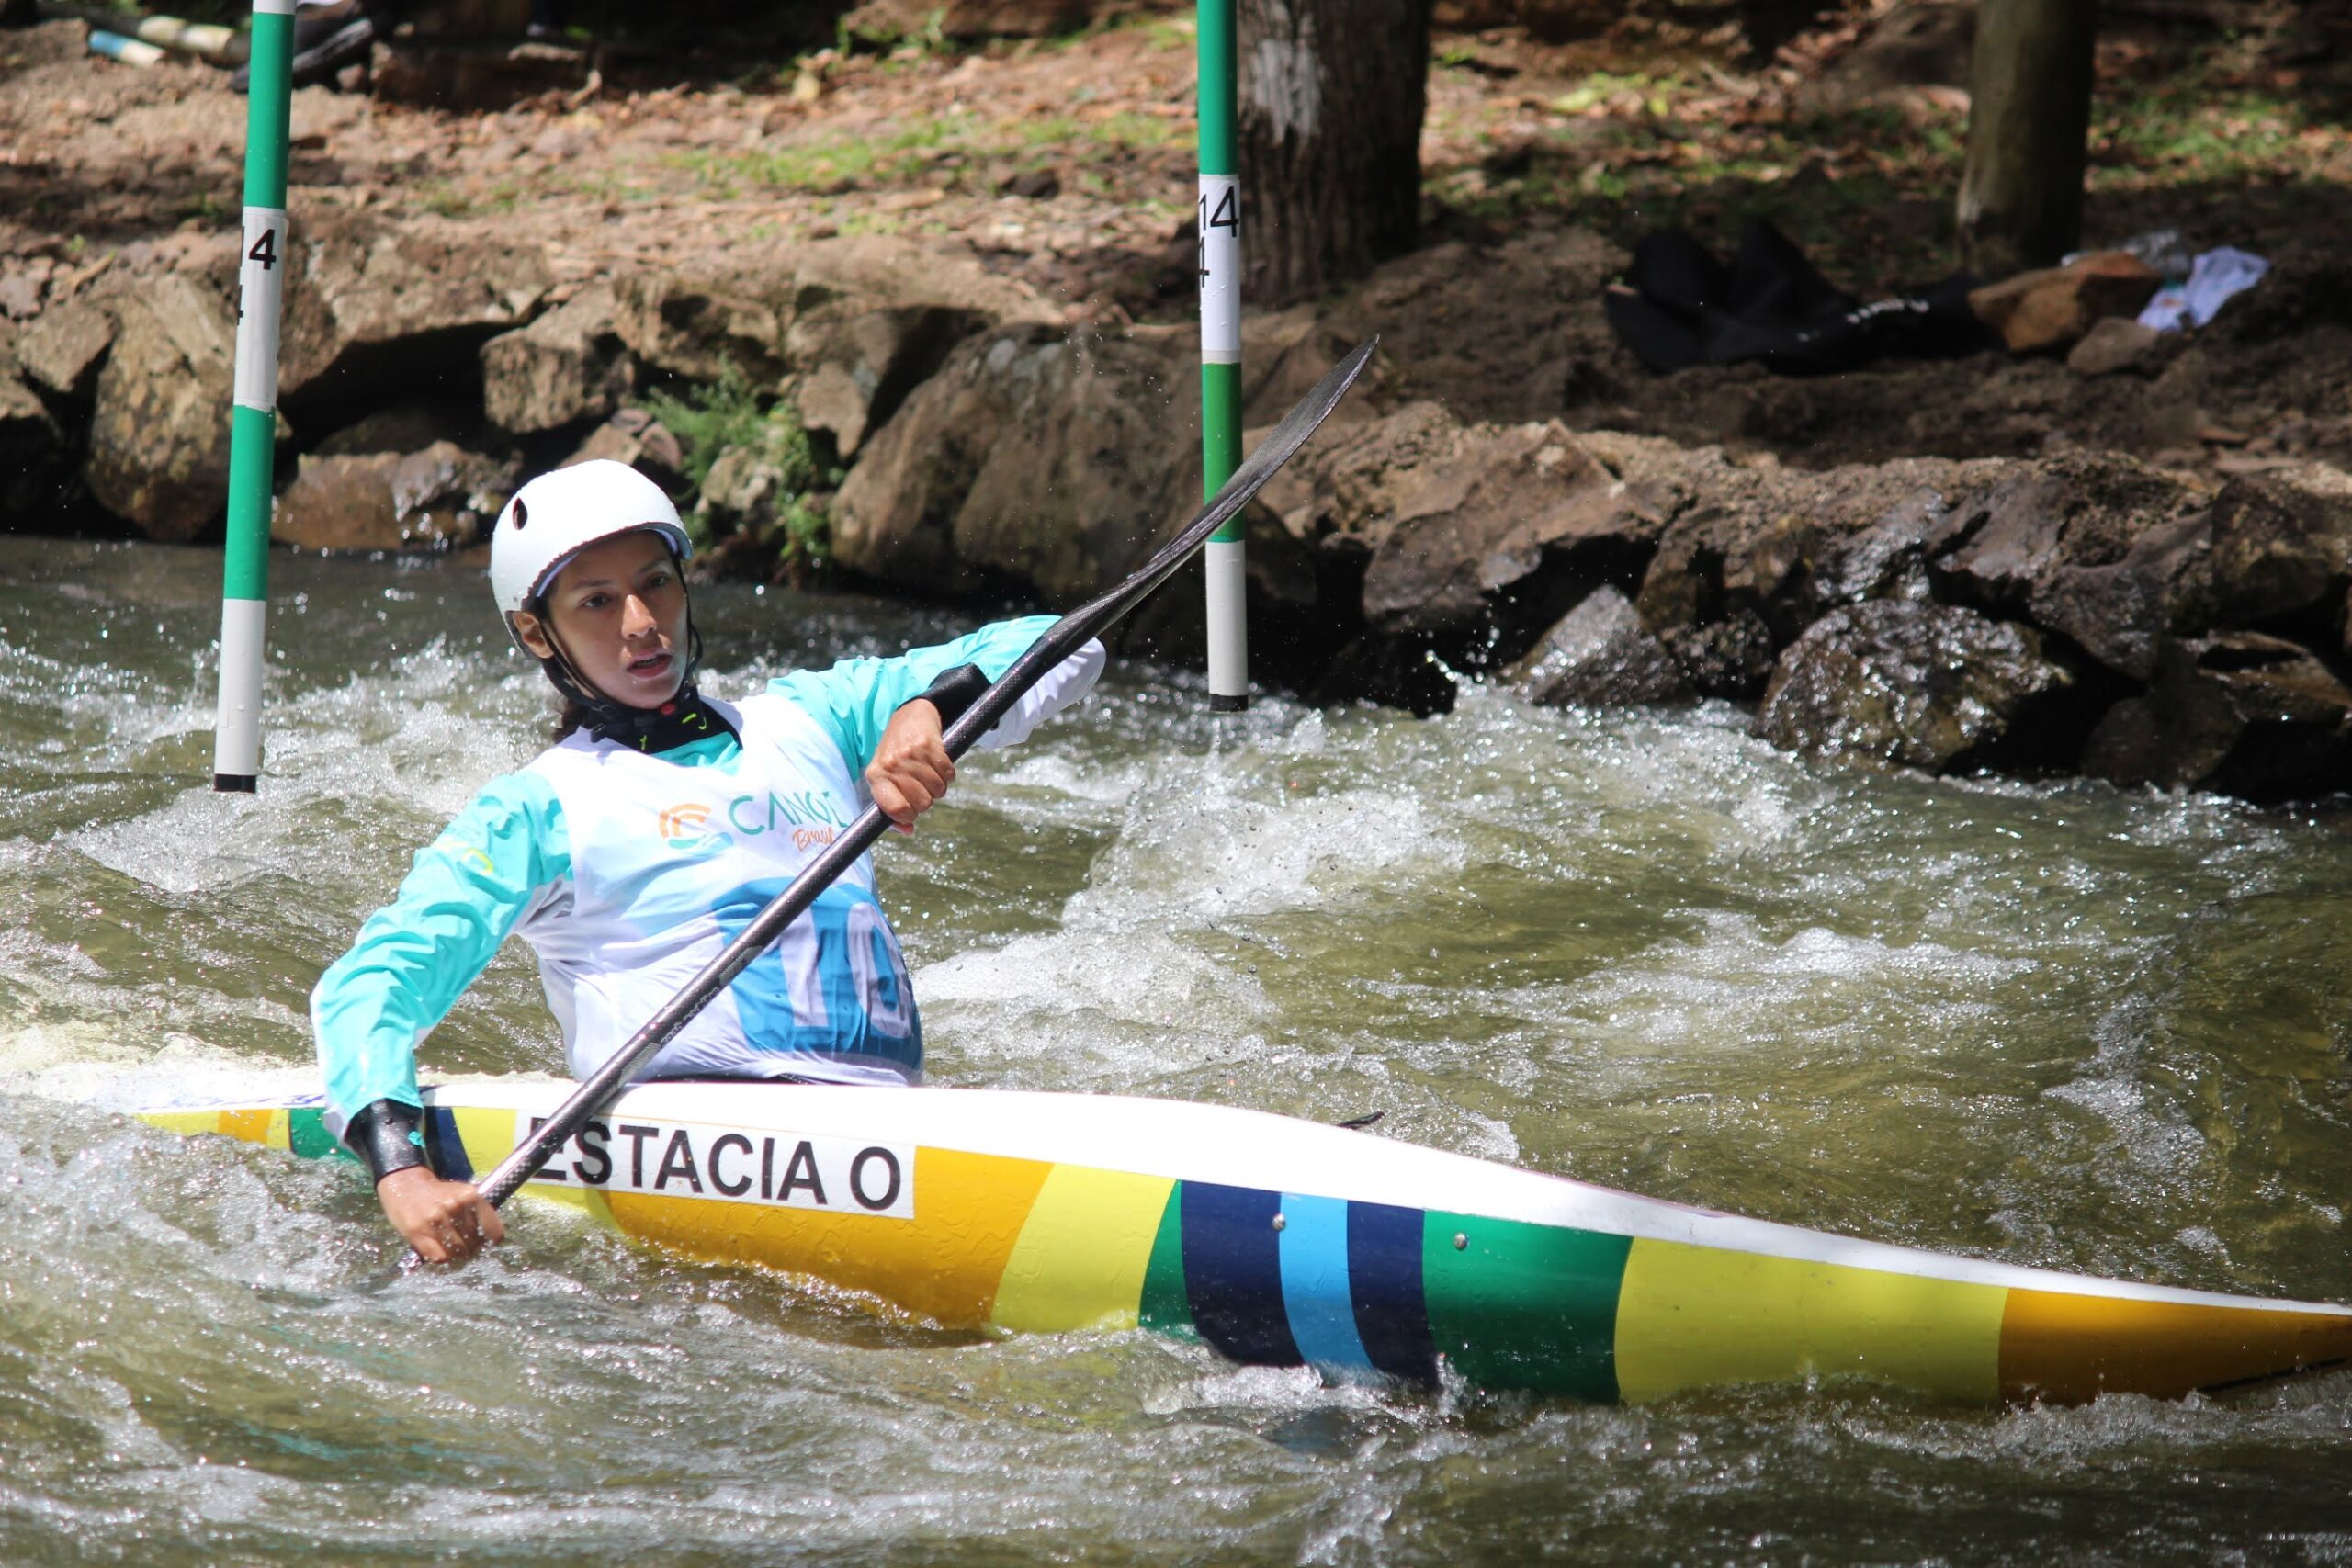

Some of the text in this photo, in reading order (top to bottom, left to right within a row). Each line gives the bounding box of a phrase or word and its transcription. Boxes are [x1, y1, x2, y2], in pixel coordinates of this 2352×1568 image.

[1199, 186, 1238, 238] 14
[240, 226, 277, 270] 4
[850, 1146, 901, 1211] O
